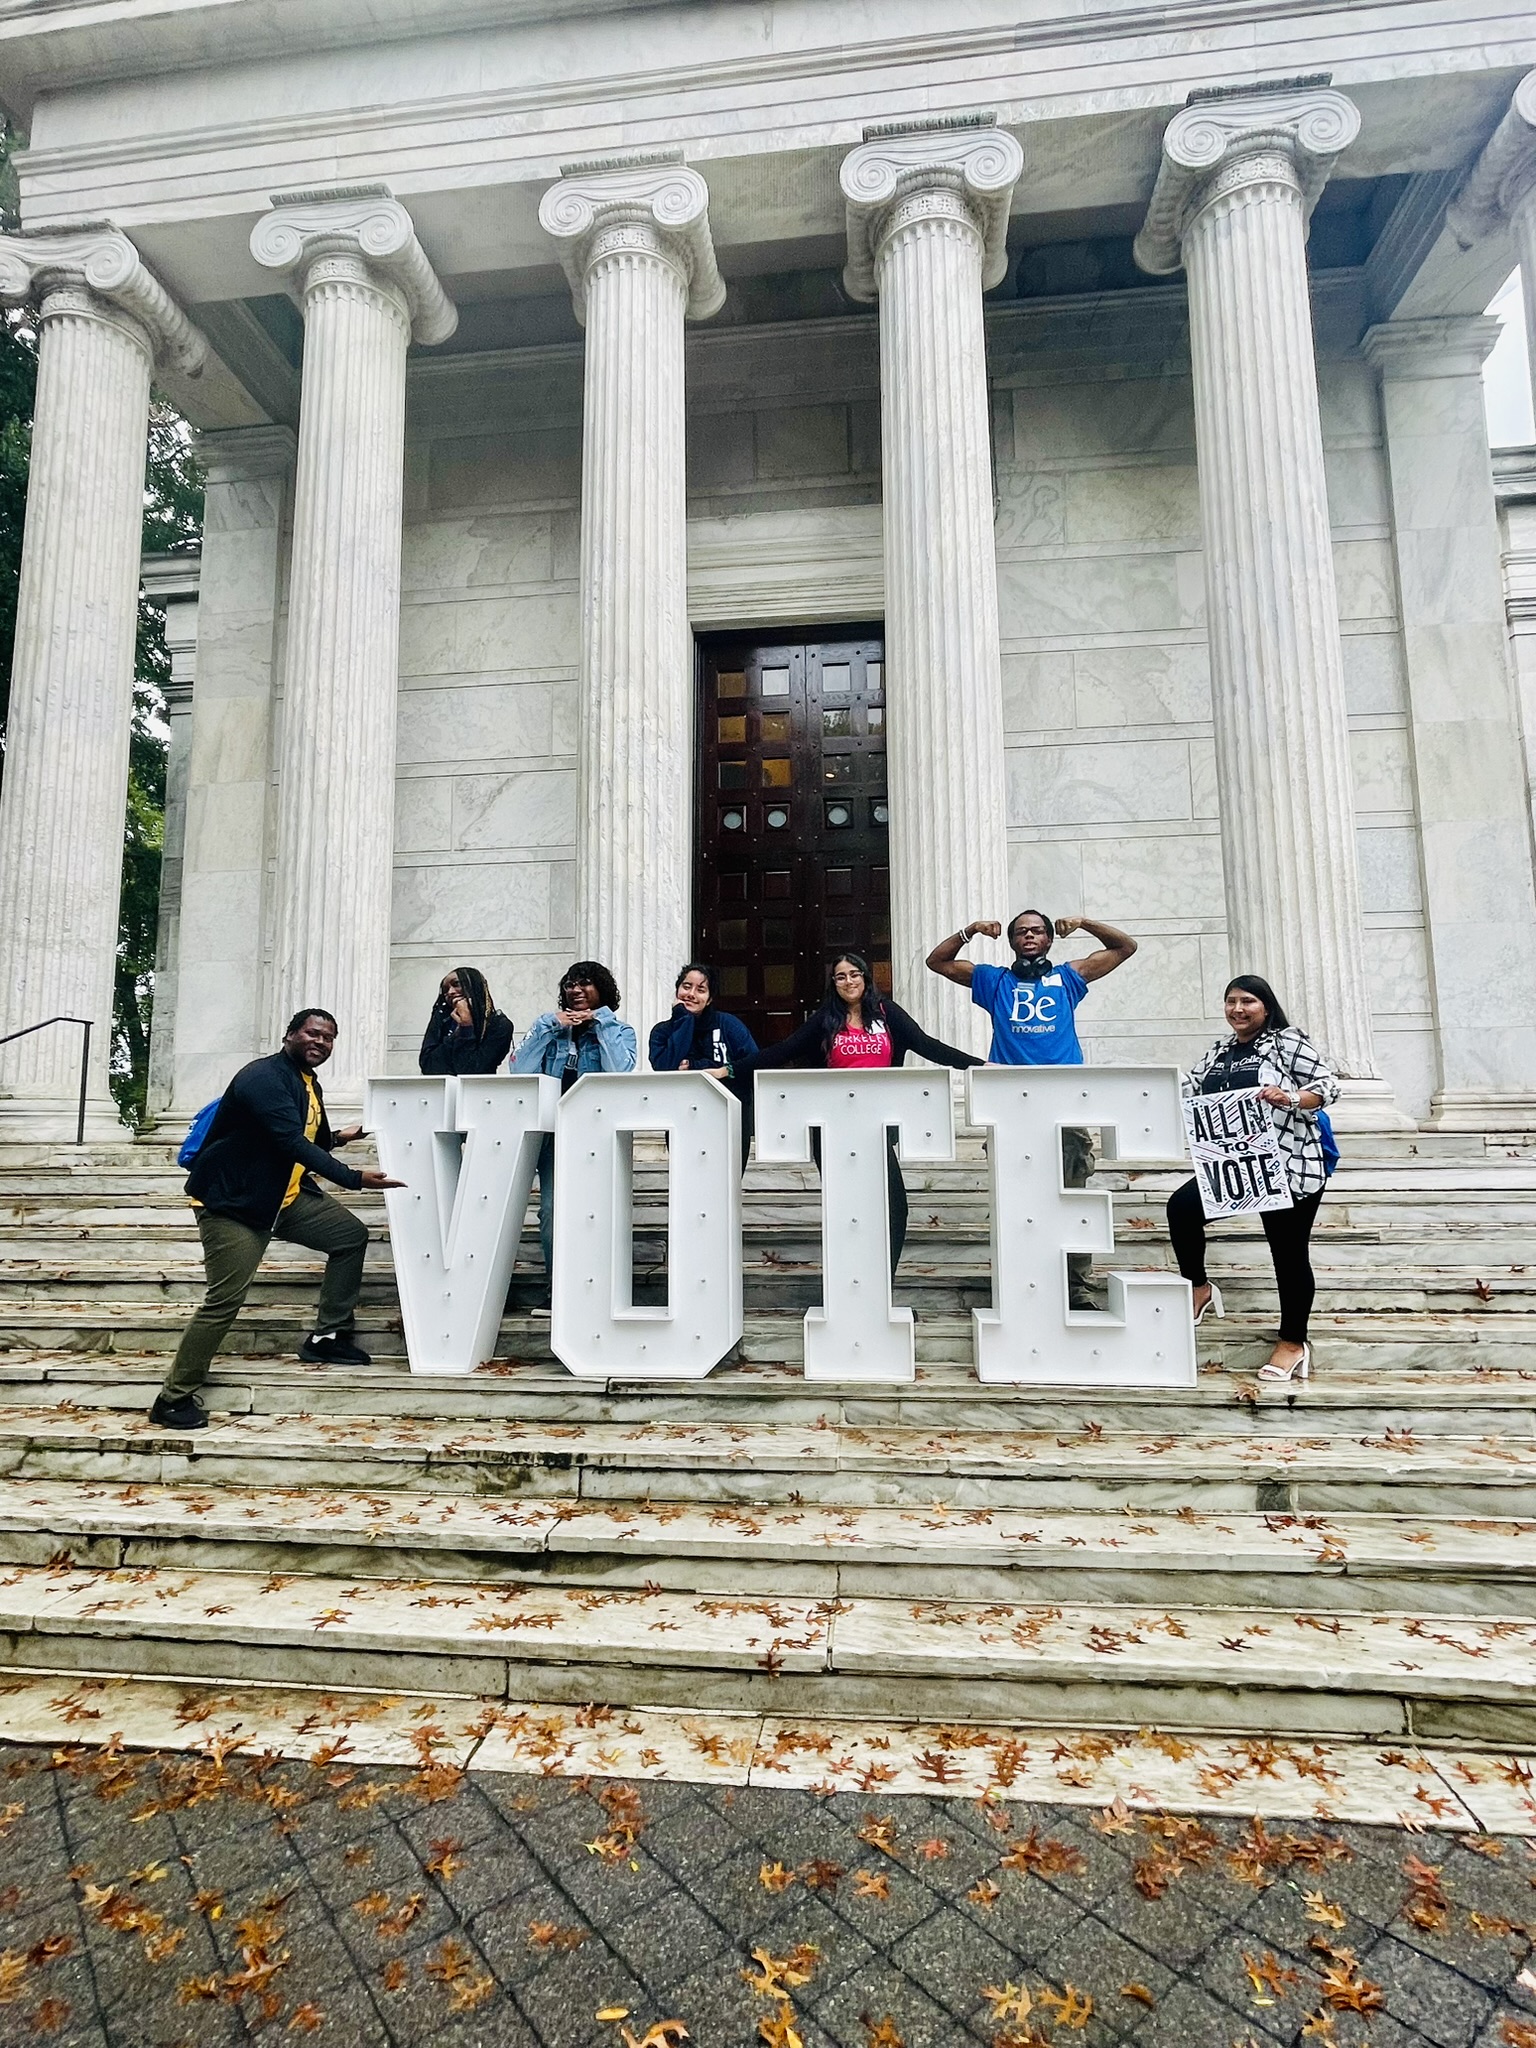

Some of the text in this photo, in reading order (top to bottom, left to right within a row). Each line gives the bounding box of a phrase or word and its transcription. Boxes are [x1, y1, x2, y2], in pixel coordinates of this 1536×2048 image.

[1009, 988, 1057, 1022] Be
[840, 1044, 883, 1055] COLLEGE
[1193, 1098, 1268, 1142] ALL IN
[1219, 1141, 1250, 1154] TO
[1202, 1153, 1282, 1203] VOTE
[364, 1064, 1198, 1388] VOTE
